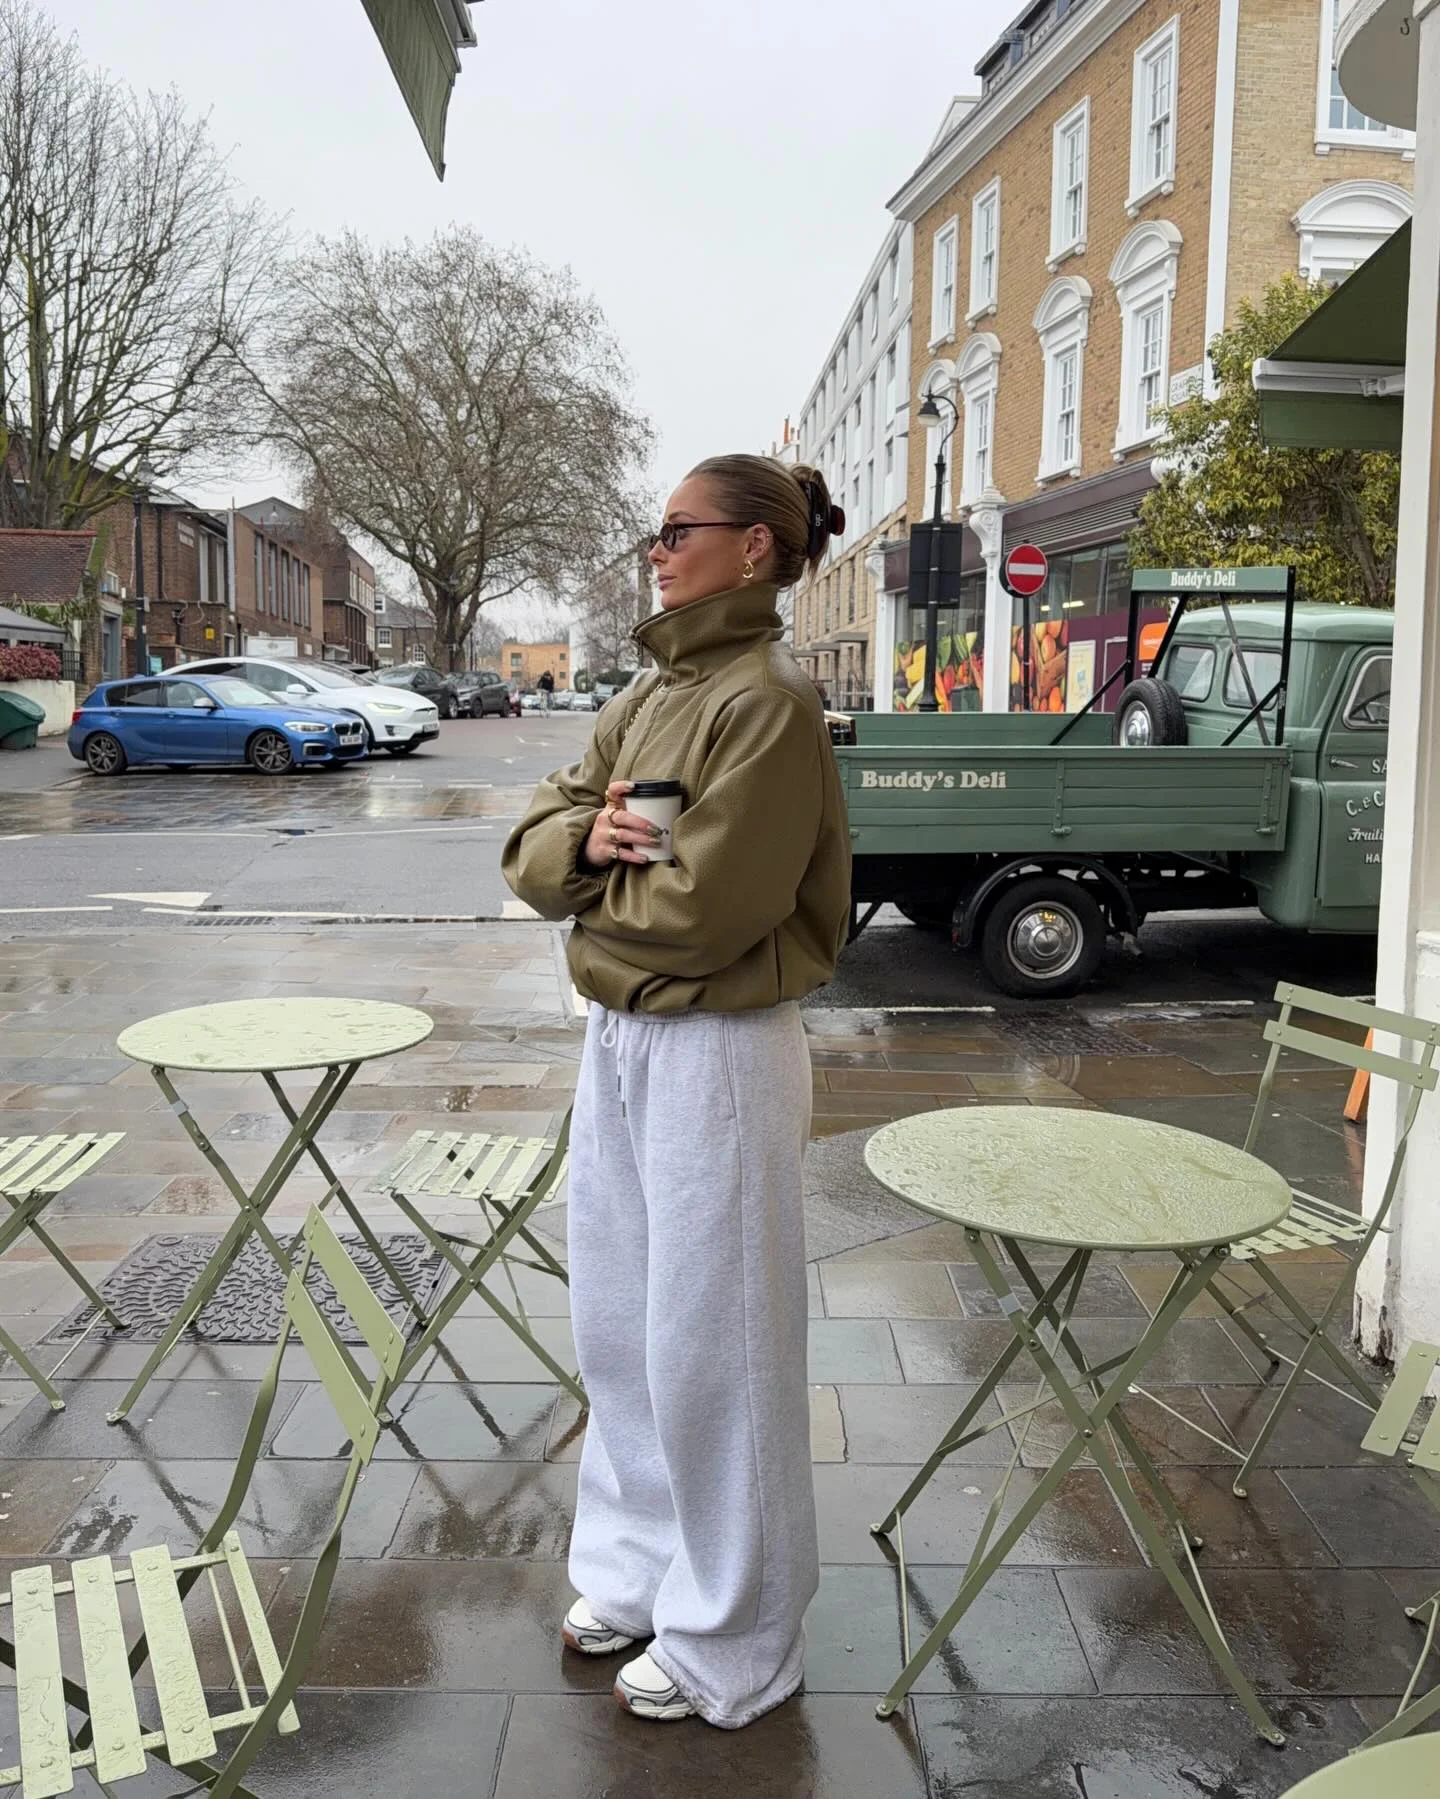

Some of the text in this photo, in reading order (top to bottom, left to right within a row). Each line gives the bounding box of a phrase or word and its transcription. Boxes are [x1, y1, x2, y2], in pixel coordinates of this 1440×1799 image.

[1170, 571, 1236, 589] Buddy's Deli
[861, 771, 1007, 792] Buddy's Deli
